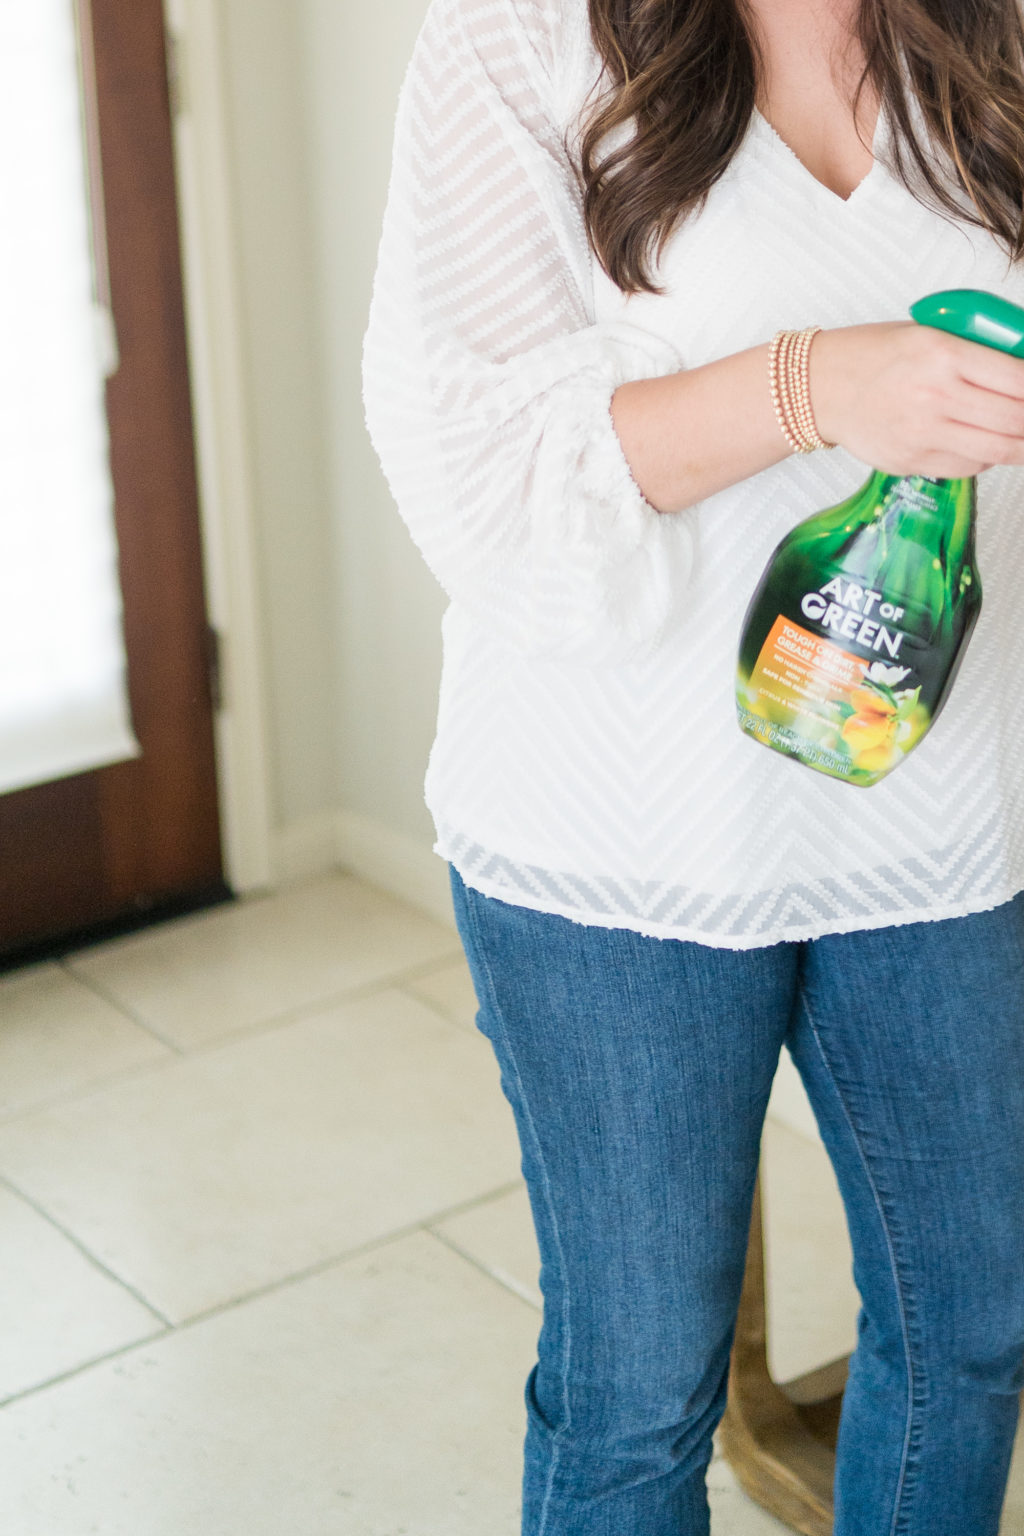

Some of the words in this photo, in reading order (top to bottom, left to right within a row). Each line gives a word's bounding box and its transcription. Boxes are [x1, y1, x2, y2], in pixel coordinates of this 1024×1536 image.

[819, 576, 882, 615] ART
[879, 602, 905, 622] OF
[782, 625, 816, 650] TOUGH
[801, 593, 903, 658] GREEN
[777, 636, 812, 661] GREASE
